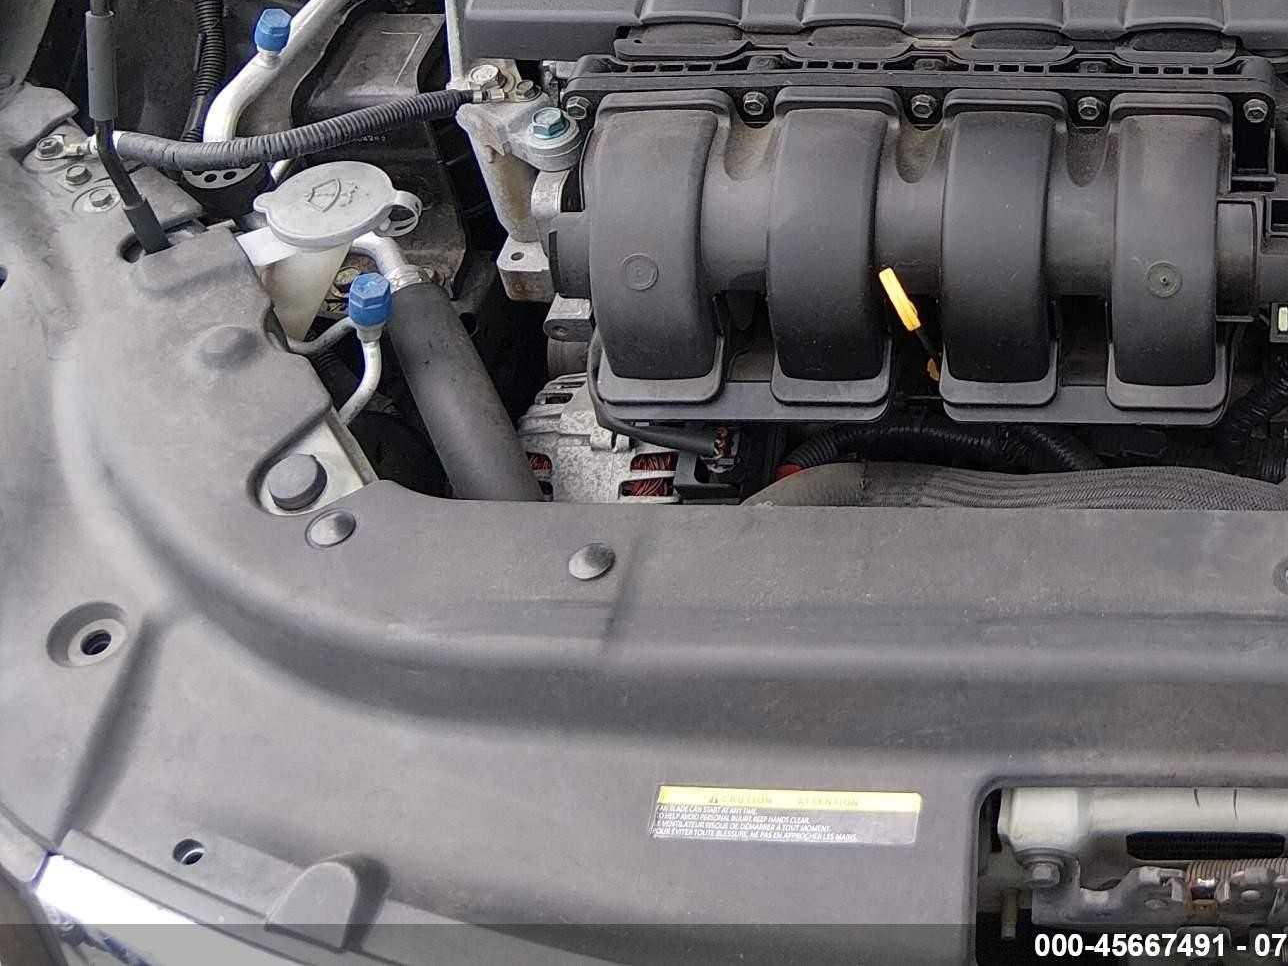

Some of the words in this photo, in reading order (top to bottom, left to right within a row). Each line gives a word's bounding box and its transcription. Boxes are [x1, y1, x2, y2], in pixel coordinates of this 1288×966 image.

[721, 795, 772, 805] CAUTION
[797, 797, 858, 807] ATTENTION
[688, 805, 703, 813] CAN
[703, 805, 721, 814] START
[729, 806, 743, 814] ANY
[664, 812, 680, 820] HELP
[679, 812, 699, 820] AVOID
[699, 813, 731, 821] PERSONAL
[752, 815, 768, 823] KEEP
[768, 816, 790, 824] HANDS
[662, 820, 705, 829] VENTILATEUR
[704, 821, 728, 829] RISQUE
[729, 822, 740, 830] DE
[782, 824, 800, 832] TOUT
[694, 828, 715, 836] TOUTE
[759, 831, 773, 839] PAS
[783, 832, 822, 840] APPROCHER
